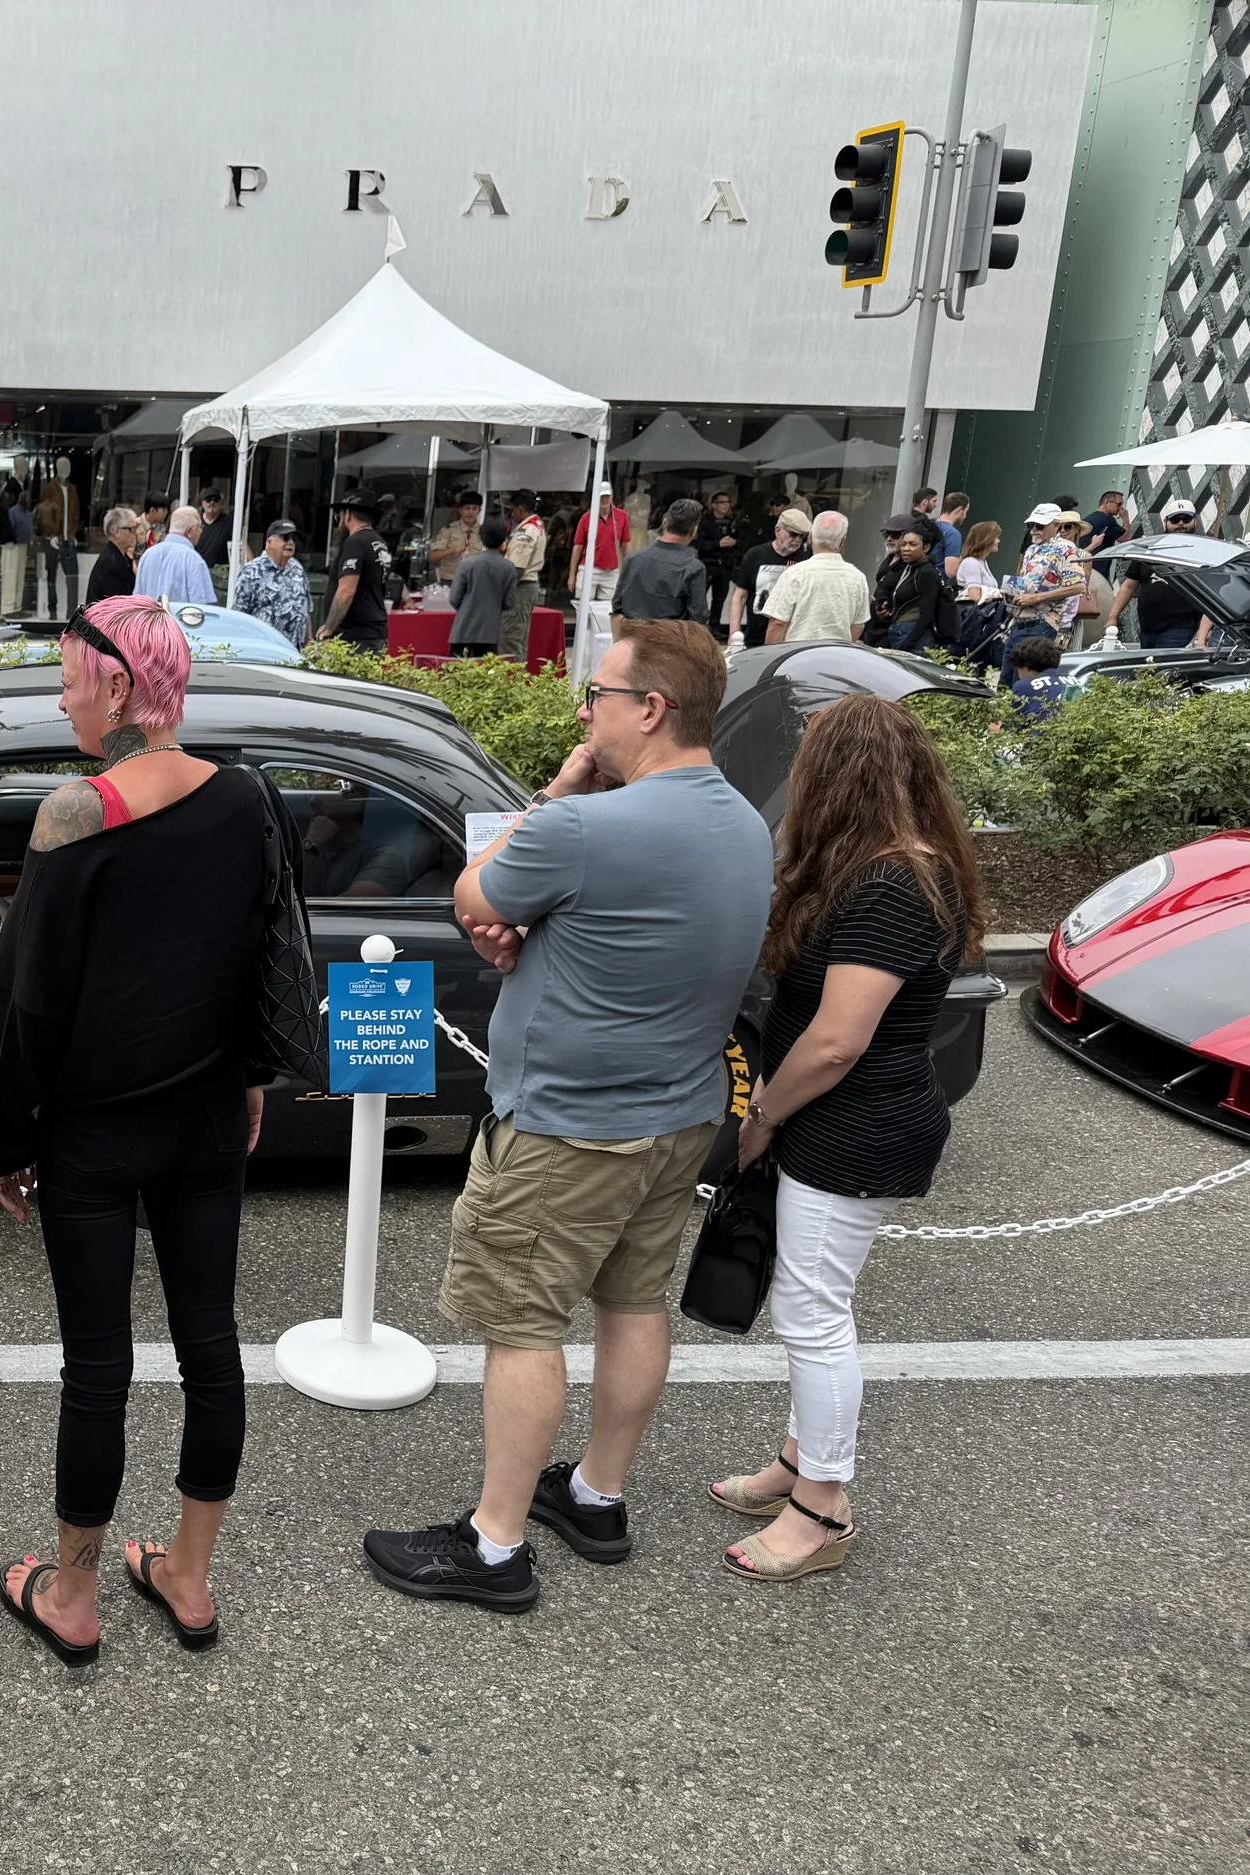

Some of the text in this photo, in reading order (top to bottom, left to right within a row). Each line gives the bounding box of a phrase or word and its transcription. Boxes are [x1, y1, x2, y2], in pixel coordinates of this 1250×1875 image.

[225, 164, 749, 223] PRADA
[340, 1009, 423, 1020] PLEASE STAY
[357, 1025, 406, 1035] BEHIND
[333, 1039, 429, 1050] THE ROPE AND
[349, 1054, 415, 1065] STANTION
[725, 1033, 750, 1118] YEAR
